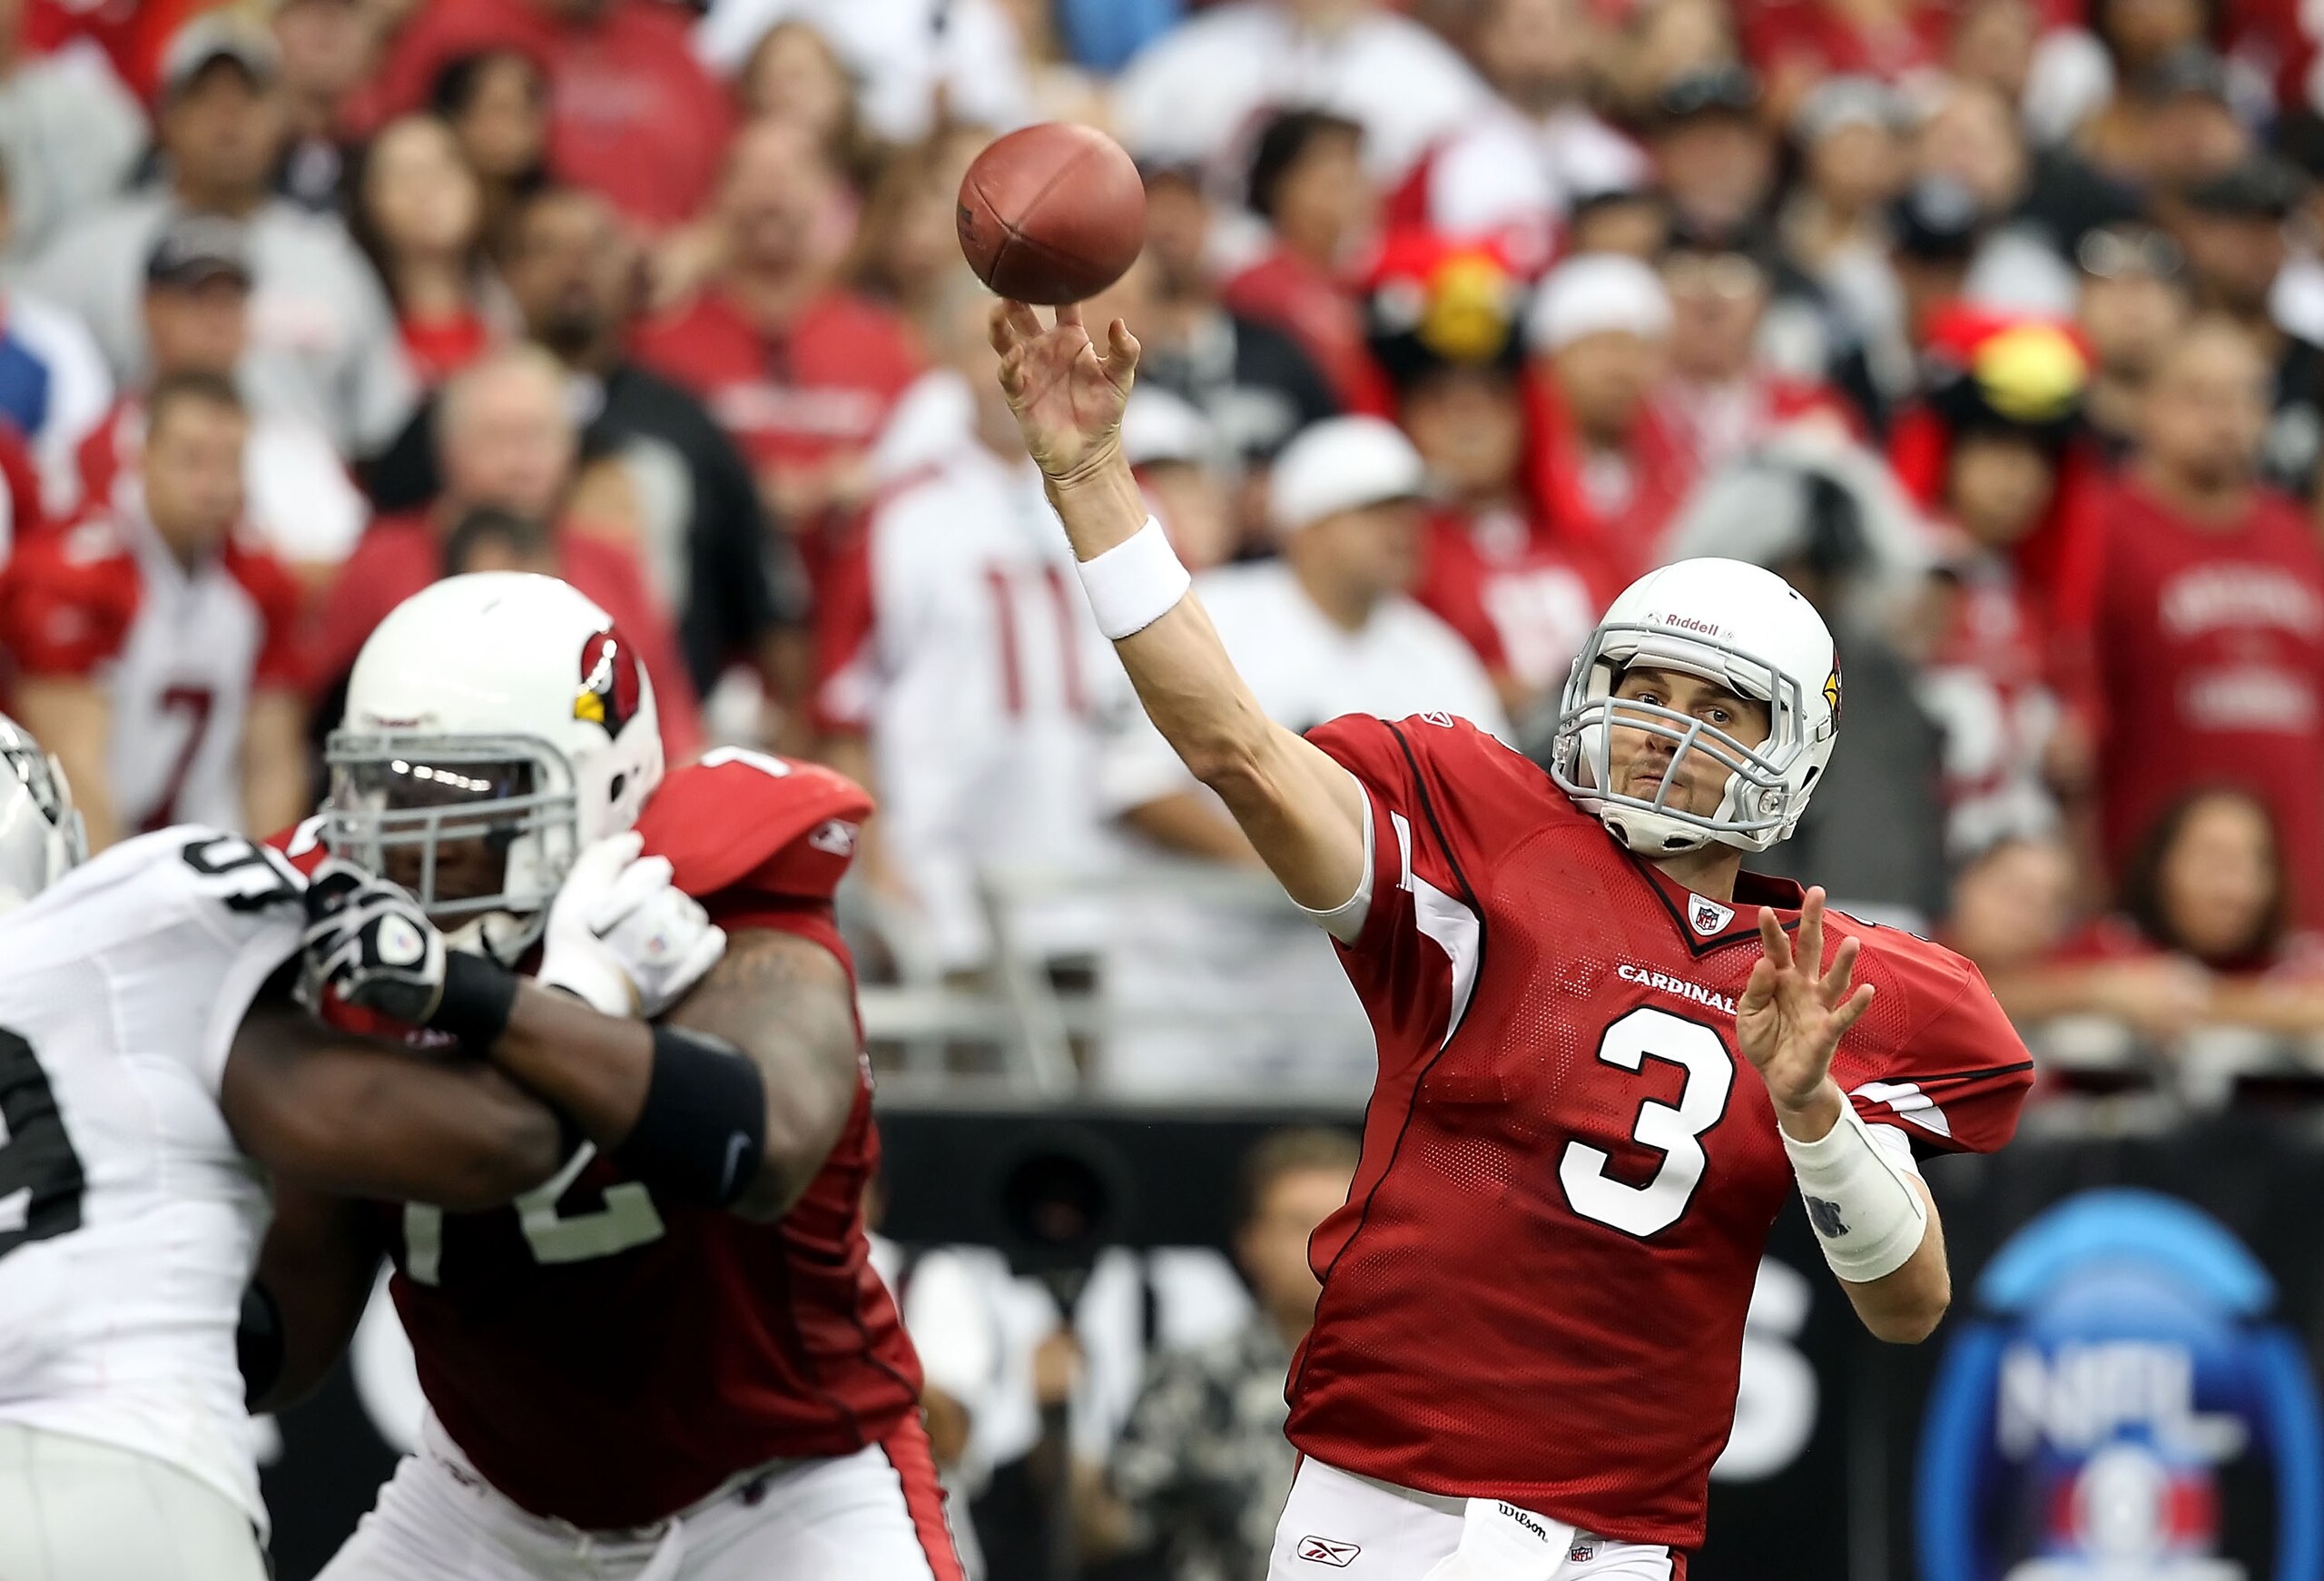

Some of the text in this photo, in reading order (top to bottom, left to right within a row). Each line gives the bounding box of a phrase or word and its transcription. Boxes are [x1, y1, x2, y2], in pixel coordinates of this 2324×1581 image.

[1666, 614, 1719, 637] Riddell
[1697, 914, 1716, 930] NFL
[1558, 1004, 1737, 1240] 3
[2000, 1342, 2244, 1458] NFL
[1499, 1502, 1546, 1541] Wilson
